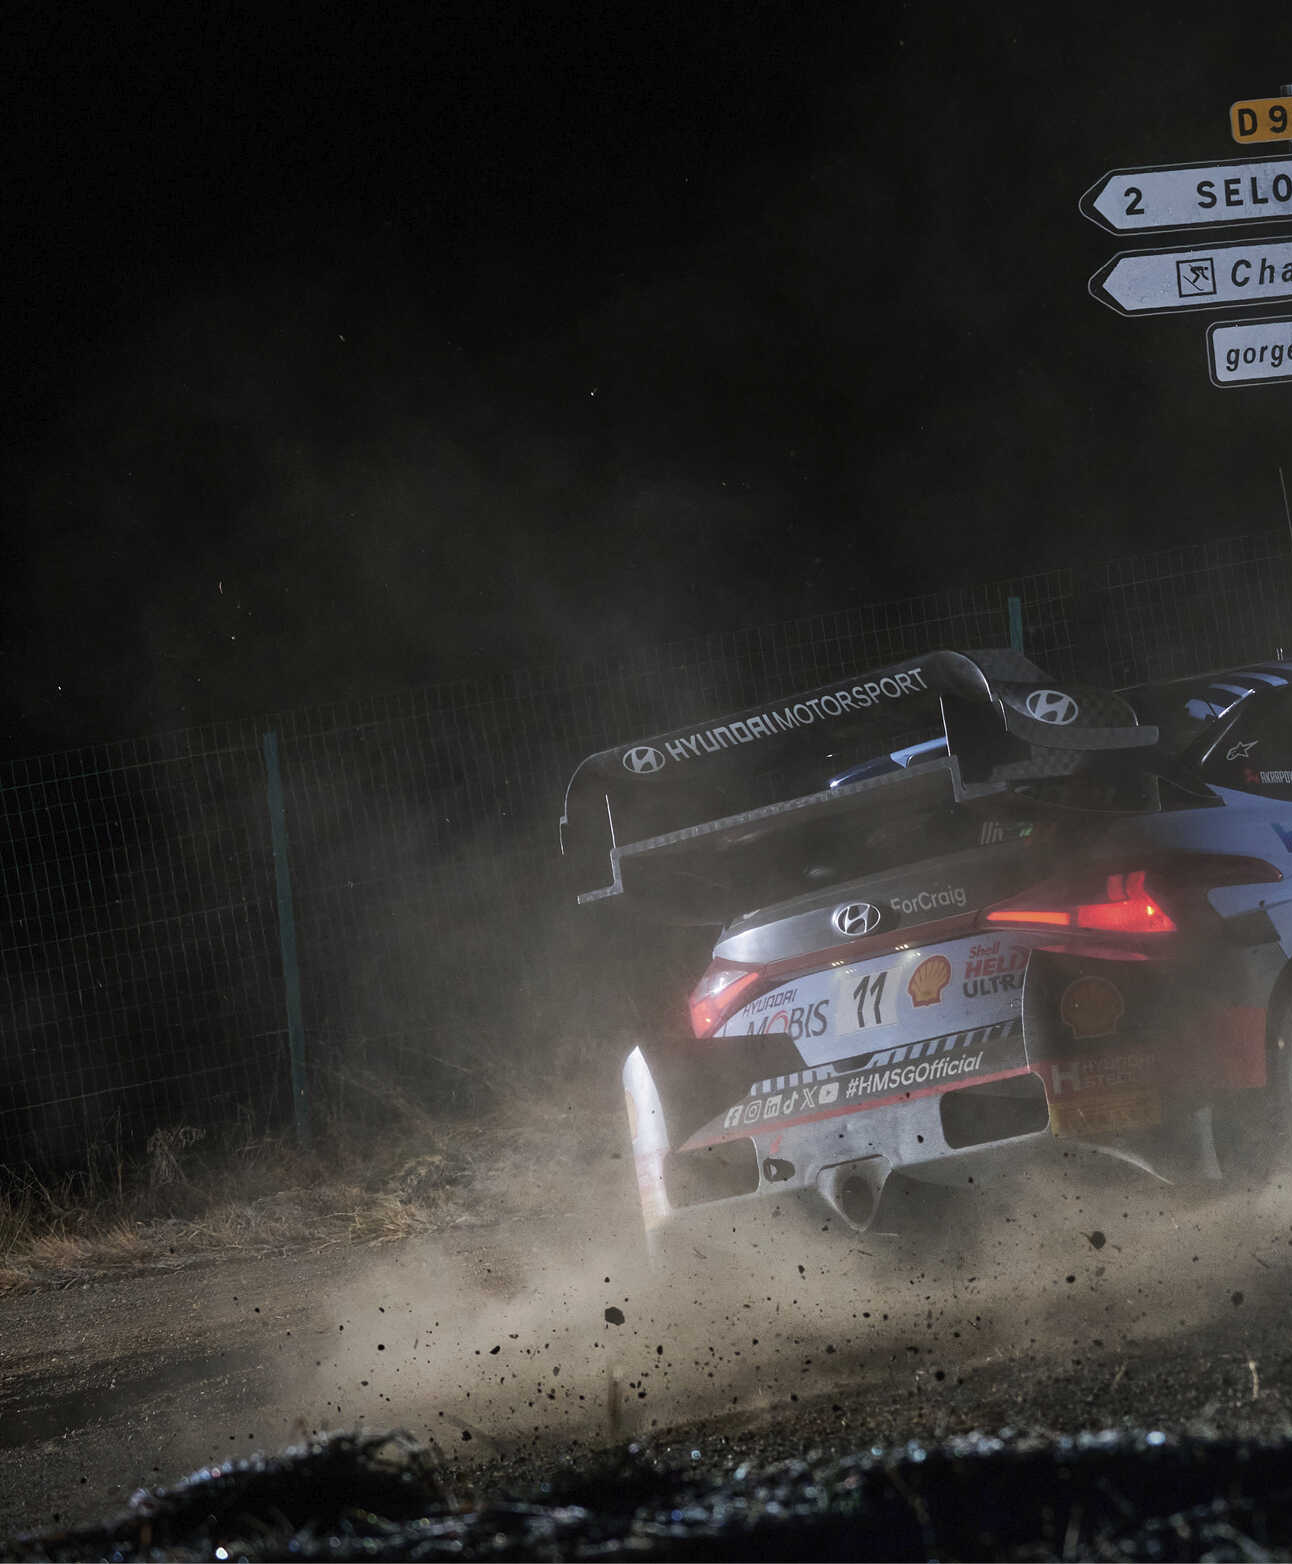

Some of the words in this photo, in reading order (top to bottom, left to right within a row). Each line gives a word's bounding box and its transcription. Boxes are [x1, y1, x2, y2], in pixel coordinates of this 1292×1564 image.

[1123, 187, 1145, 216] 2
[853, 971, 888, 1028] 11
[846, 1050, 983, 1099] #HMSGOfficial
